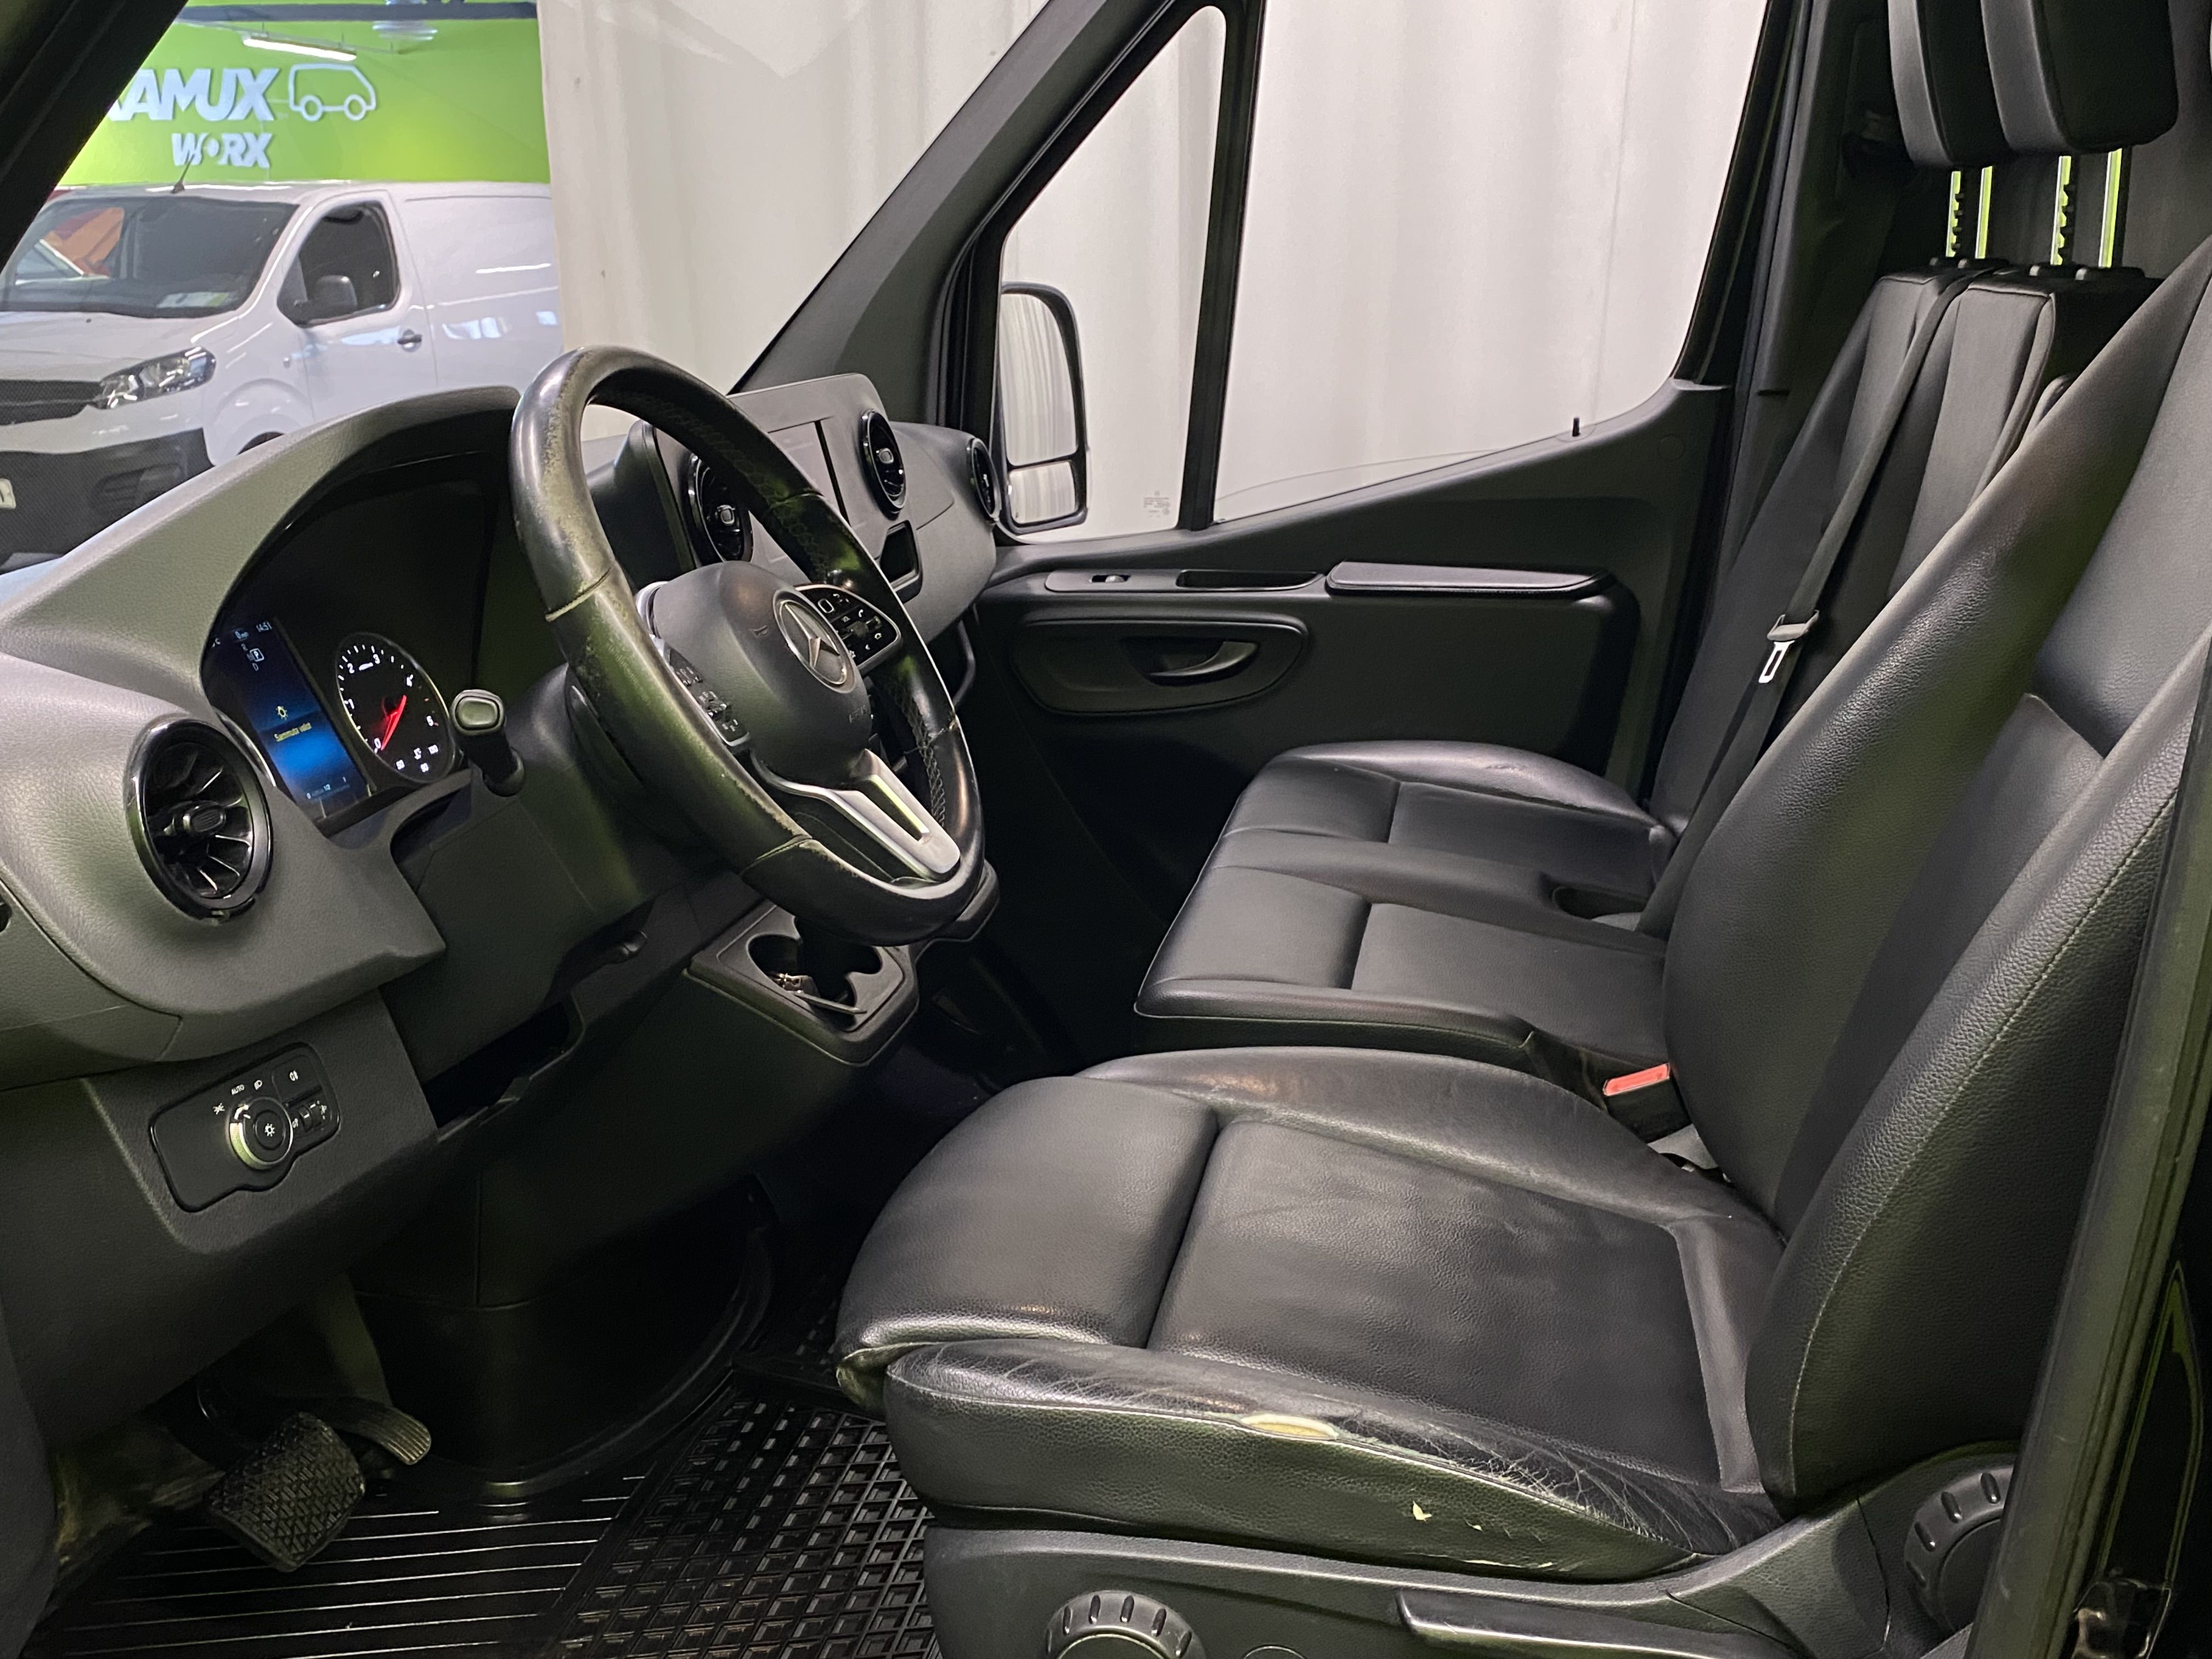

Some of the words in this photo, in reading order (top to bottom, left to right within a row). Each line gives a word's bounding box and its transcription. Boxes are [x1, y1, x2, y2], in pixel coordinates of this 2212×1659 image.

[373, 653, 381, 664] 3
[347, 663, 355, 674] 2
[406, 675, 413, 687] 4
[348, 698, 354, 709] 1
[426, 715, 434, 727] 5
[374, 737, 382, 749] 0
[231, 1084, 245, 1095] AUTO
